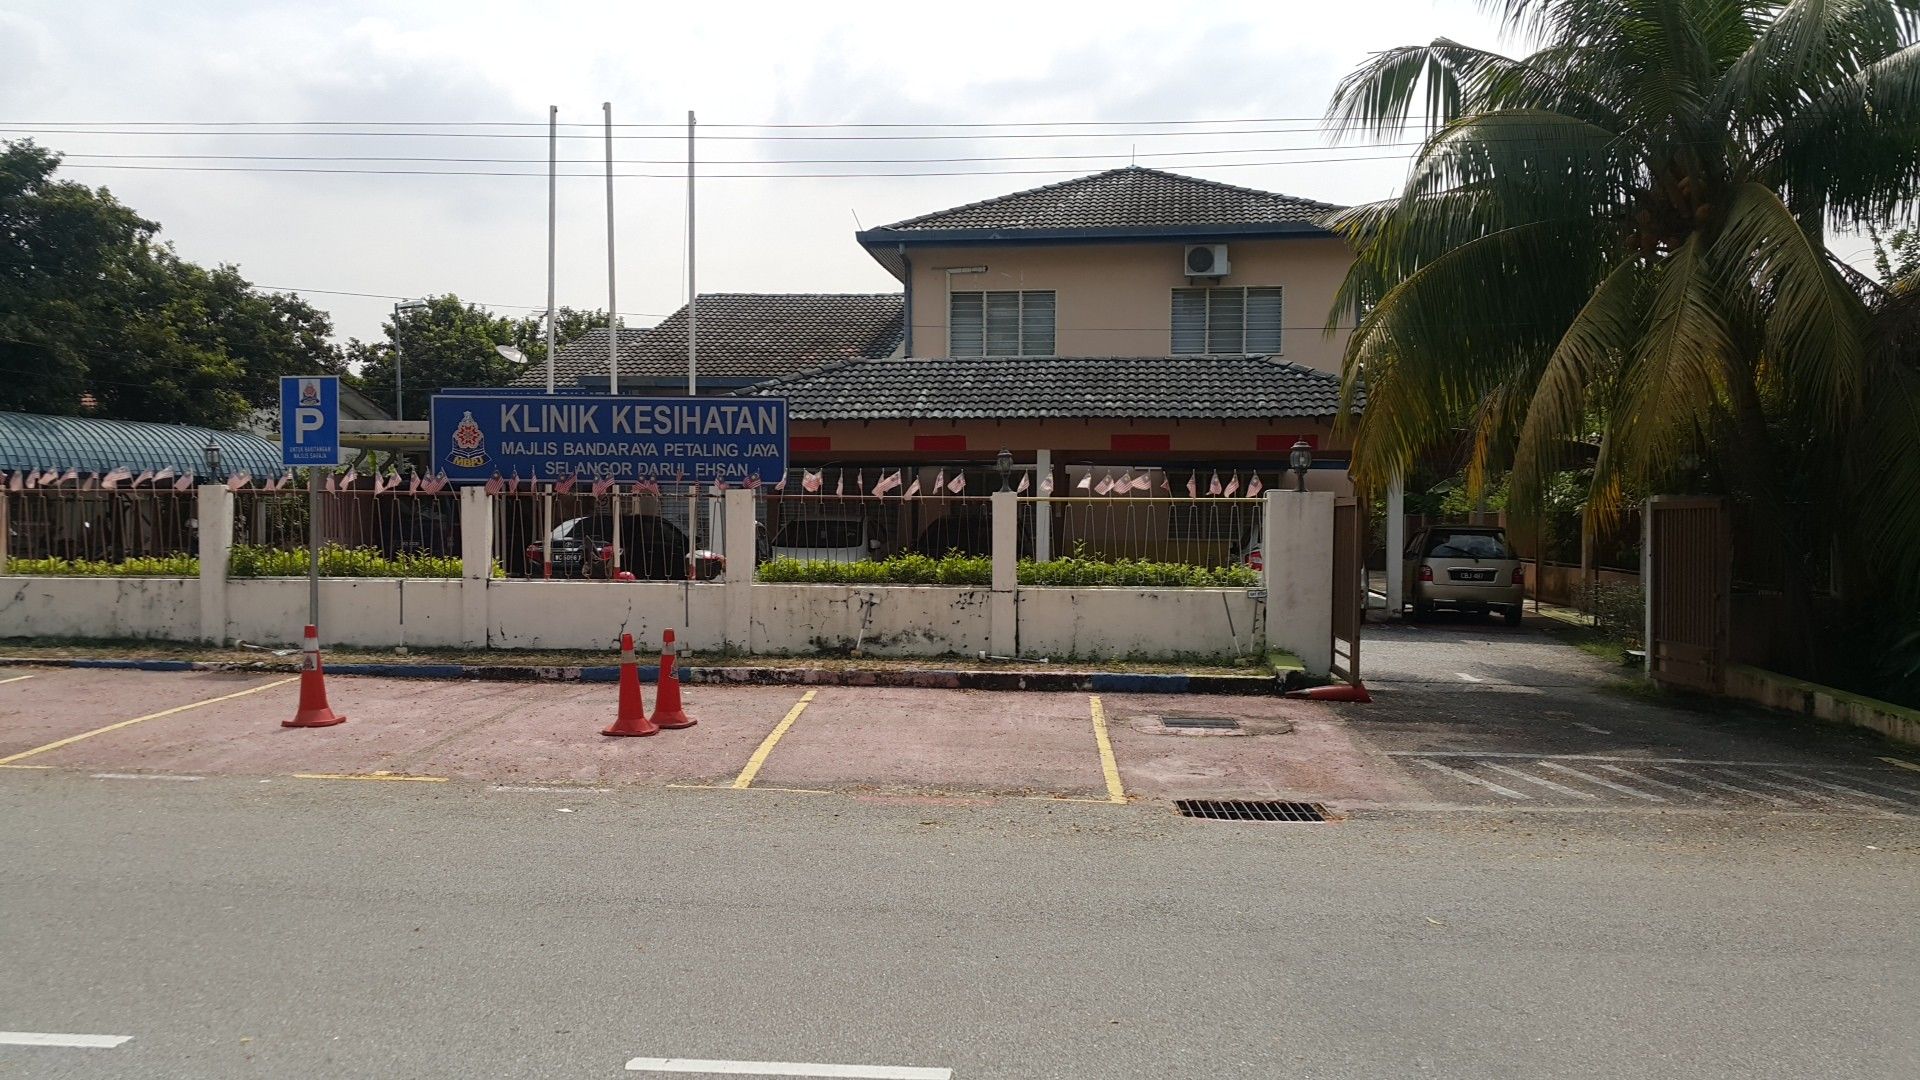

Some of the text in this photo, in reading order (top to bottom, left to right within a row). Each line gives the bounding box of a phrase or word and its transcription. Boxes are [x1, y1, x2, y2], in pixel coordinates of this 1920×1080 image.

[295, 407, 324, 444] P
[501, 404, 777, 435] KLINIK KESIHATAN
[501, 441, 779, 457] MAJLIS BANDARAYA PETALING JAYA
[453, 456, 484, 468] MBPJ
[545, 461, 749, 477] SELANGOR DARUL EHSAN
